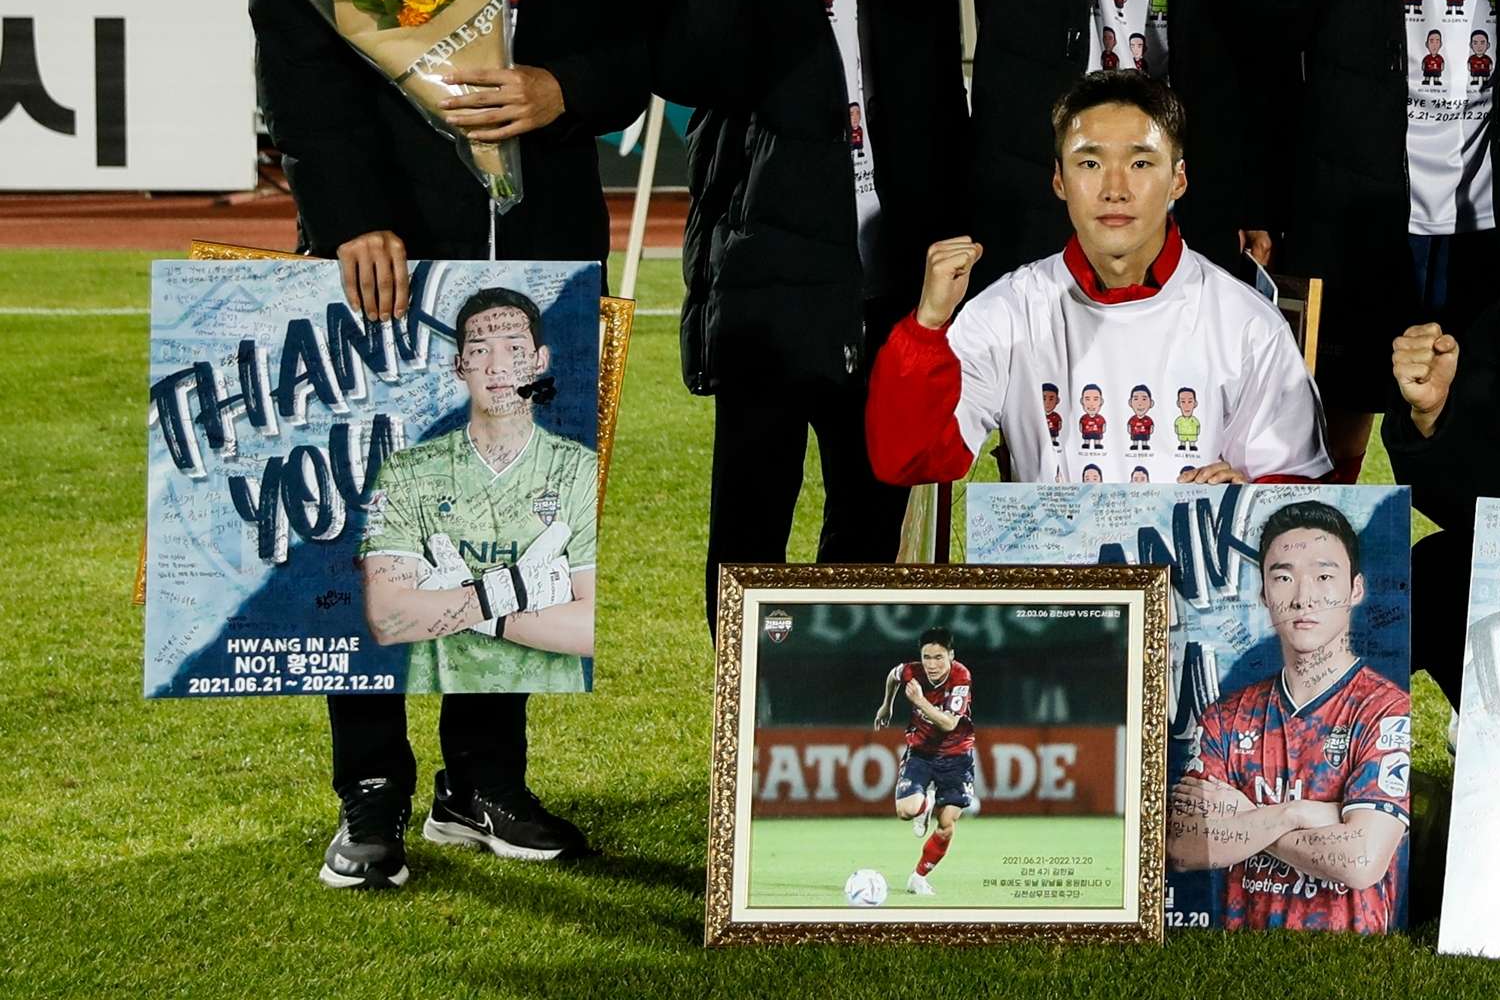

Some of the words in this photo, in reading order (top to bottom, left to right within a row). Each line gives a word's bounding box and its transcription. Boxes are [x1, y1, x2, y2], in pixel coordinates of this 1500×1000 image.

[407, 24, 478, 74] TABLE
[0, 17, 127, 167] 시
[149, 260, 458, 480] THANK
[229, 414, 408, 564] YOU
[459, 540, 519, 563] NH
[1016, 609, 1048, 618] 22.03.06
[1077, 609, 1089, 618] VS
[227, 638, 302, 653] HWANG
[307, 637, 325, 652] IN
[329, 637, 360, 652] JAE
[235, 656, 280, 674] NO1.
[287, 654, 350, 674] 황인재
[189, 677, 283, 693] 2021.06.21
[302, 675, 395, 691] 2022.12.20
[1255, 776, 1302, 803] NH
[1242, 876, 1290, 895] together
